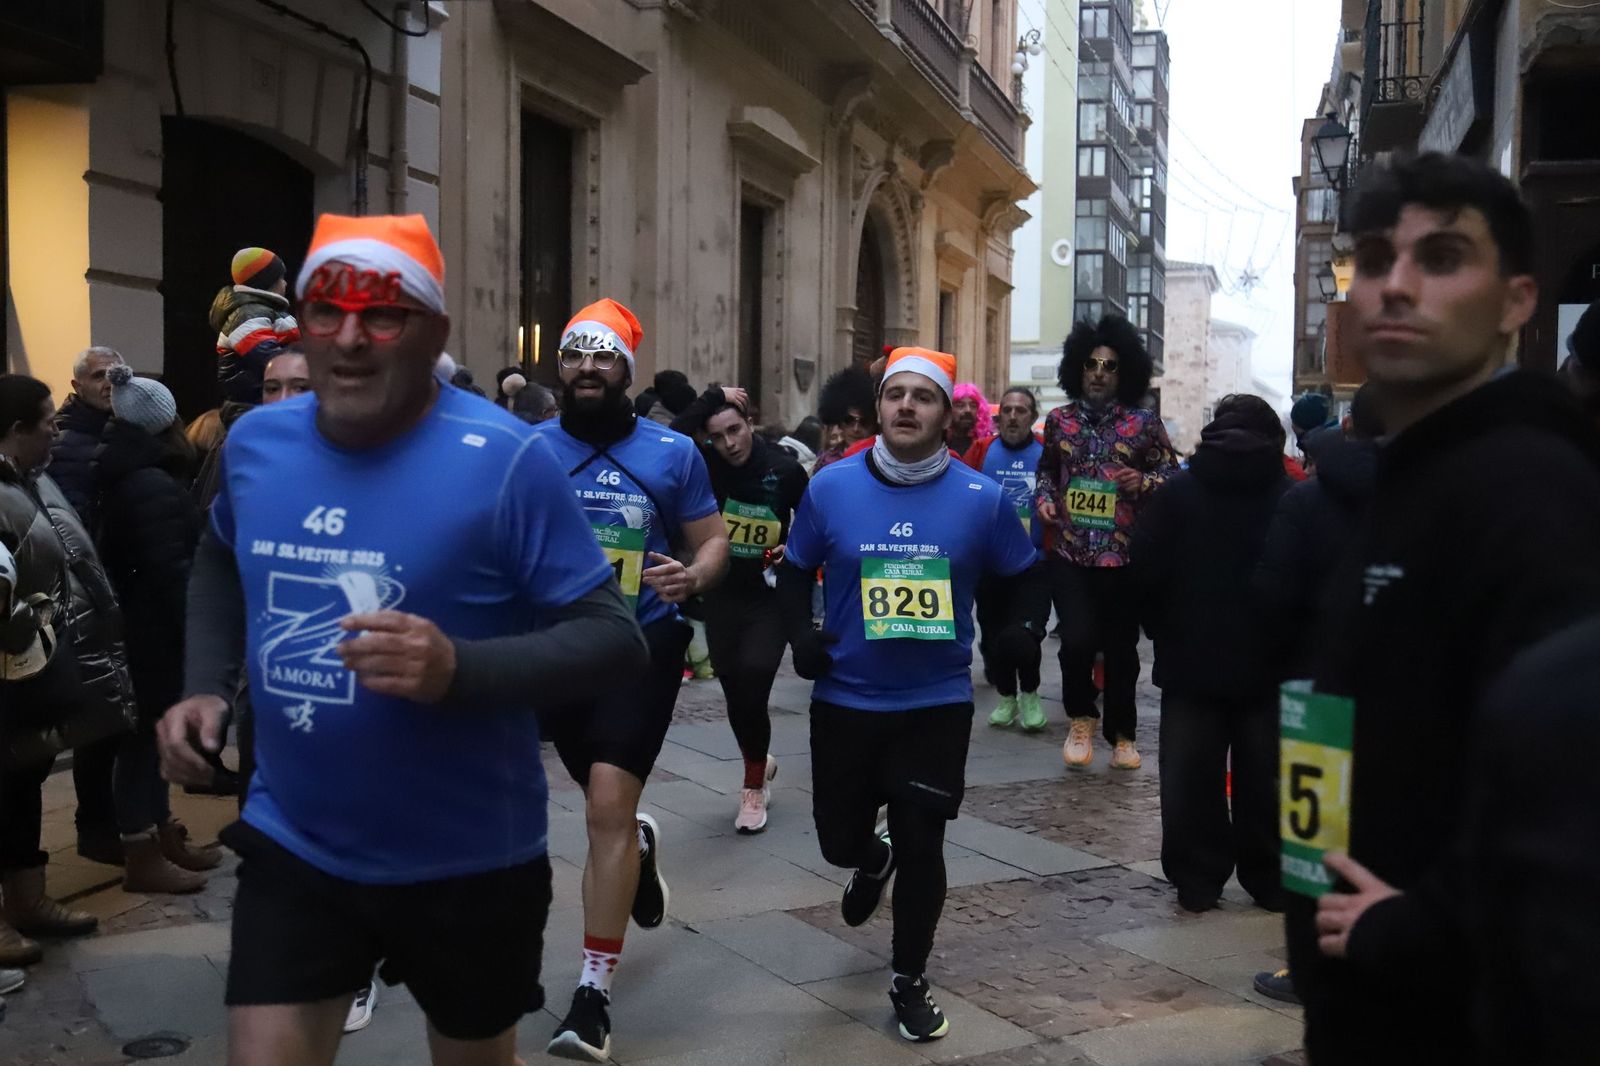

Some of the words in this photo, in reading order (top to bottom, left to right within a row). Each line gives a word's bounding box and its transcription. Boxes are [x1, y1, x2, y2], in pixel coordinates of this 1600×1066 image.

[563, 330, 617, 350] 2026
[596, 469, 621, 486] 46
[583, 490, 626, 501] SILVESTRE
[1070, 491, 1107, 513] 1244
[302, 505, 348, 536] 46
[889, 522, 914, 537] 46
[727, 519, 768, 545] 718
[251, 540, 275, 555] SAN
[277, 543, 349, 564] SILVESTRE
[860, 543, 875, 552] SAN
[877, 544, 918, 552] SILVESTRE
[868, 586, 940, 619] 829
[891, 623, 915, 633] CAJA
[916, 624, 950, 634] RURAL
